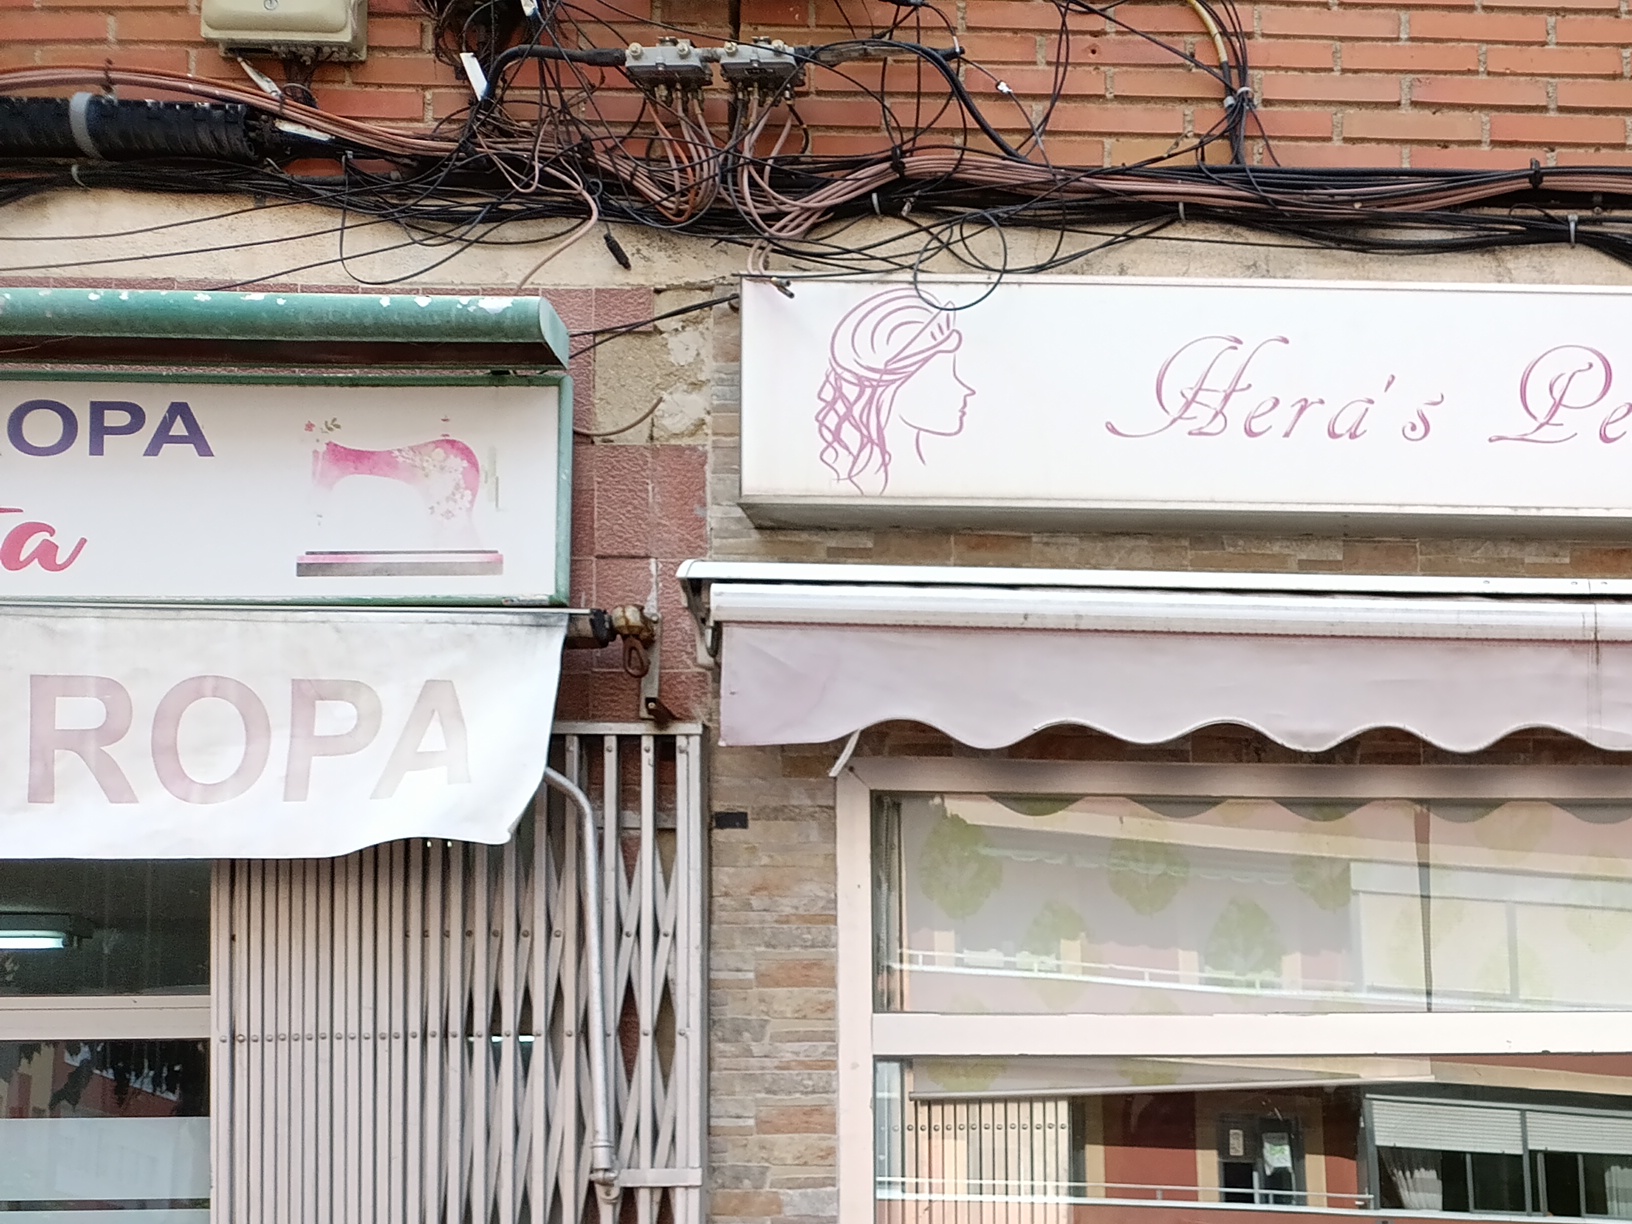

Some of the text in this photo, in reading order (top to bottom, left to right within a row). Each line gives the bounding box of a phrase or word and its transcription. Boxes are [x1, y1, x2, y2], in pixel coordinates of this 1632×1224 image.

[0, 398, 215, 457] OPA
[1105, 335, 1445, 442] Hera's
[27, 674, 472, 804] ROPA
